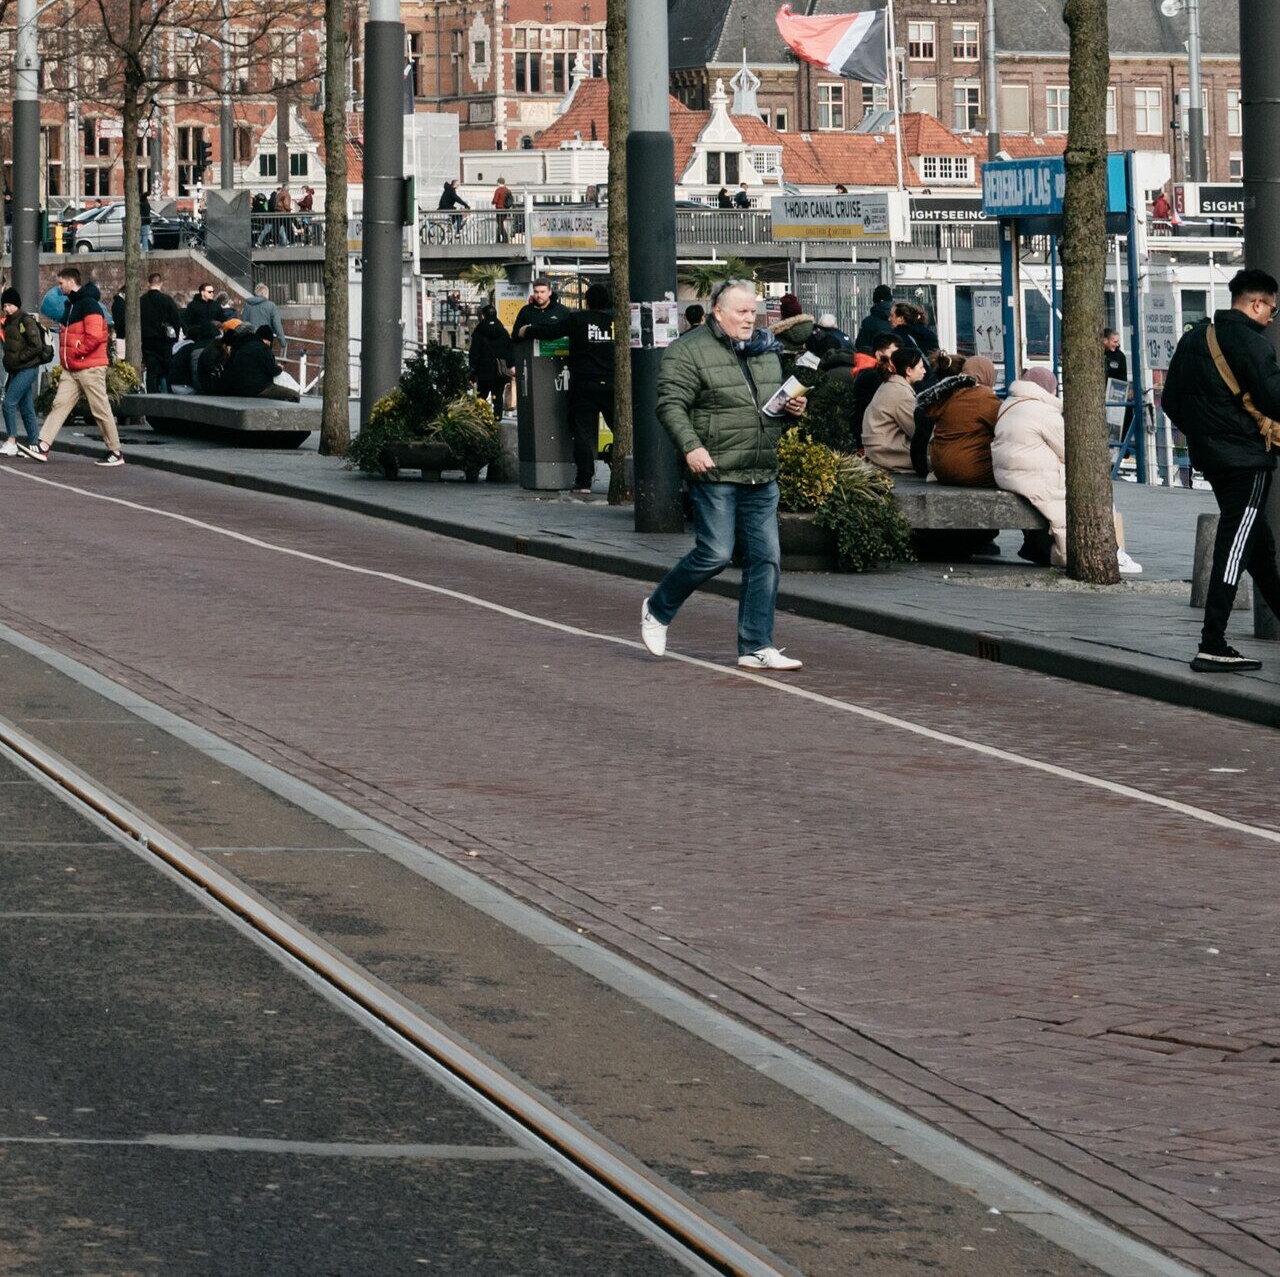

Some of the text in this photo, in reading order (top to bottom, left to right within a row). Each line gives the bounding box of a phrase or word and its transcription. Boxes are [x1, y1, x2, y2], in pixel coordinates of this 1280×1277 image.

[785, 202, 809, 218] 1-HOUR
[810, 201, 834, 218] CANAL
[836, 201, 861, 218] CRUISE
[909, 210, 987, 220] IGHTSEEING
